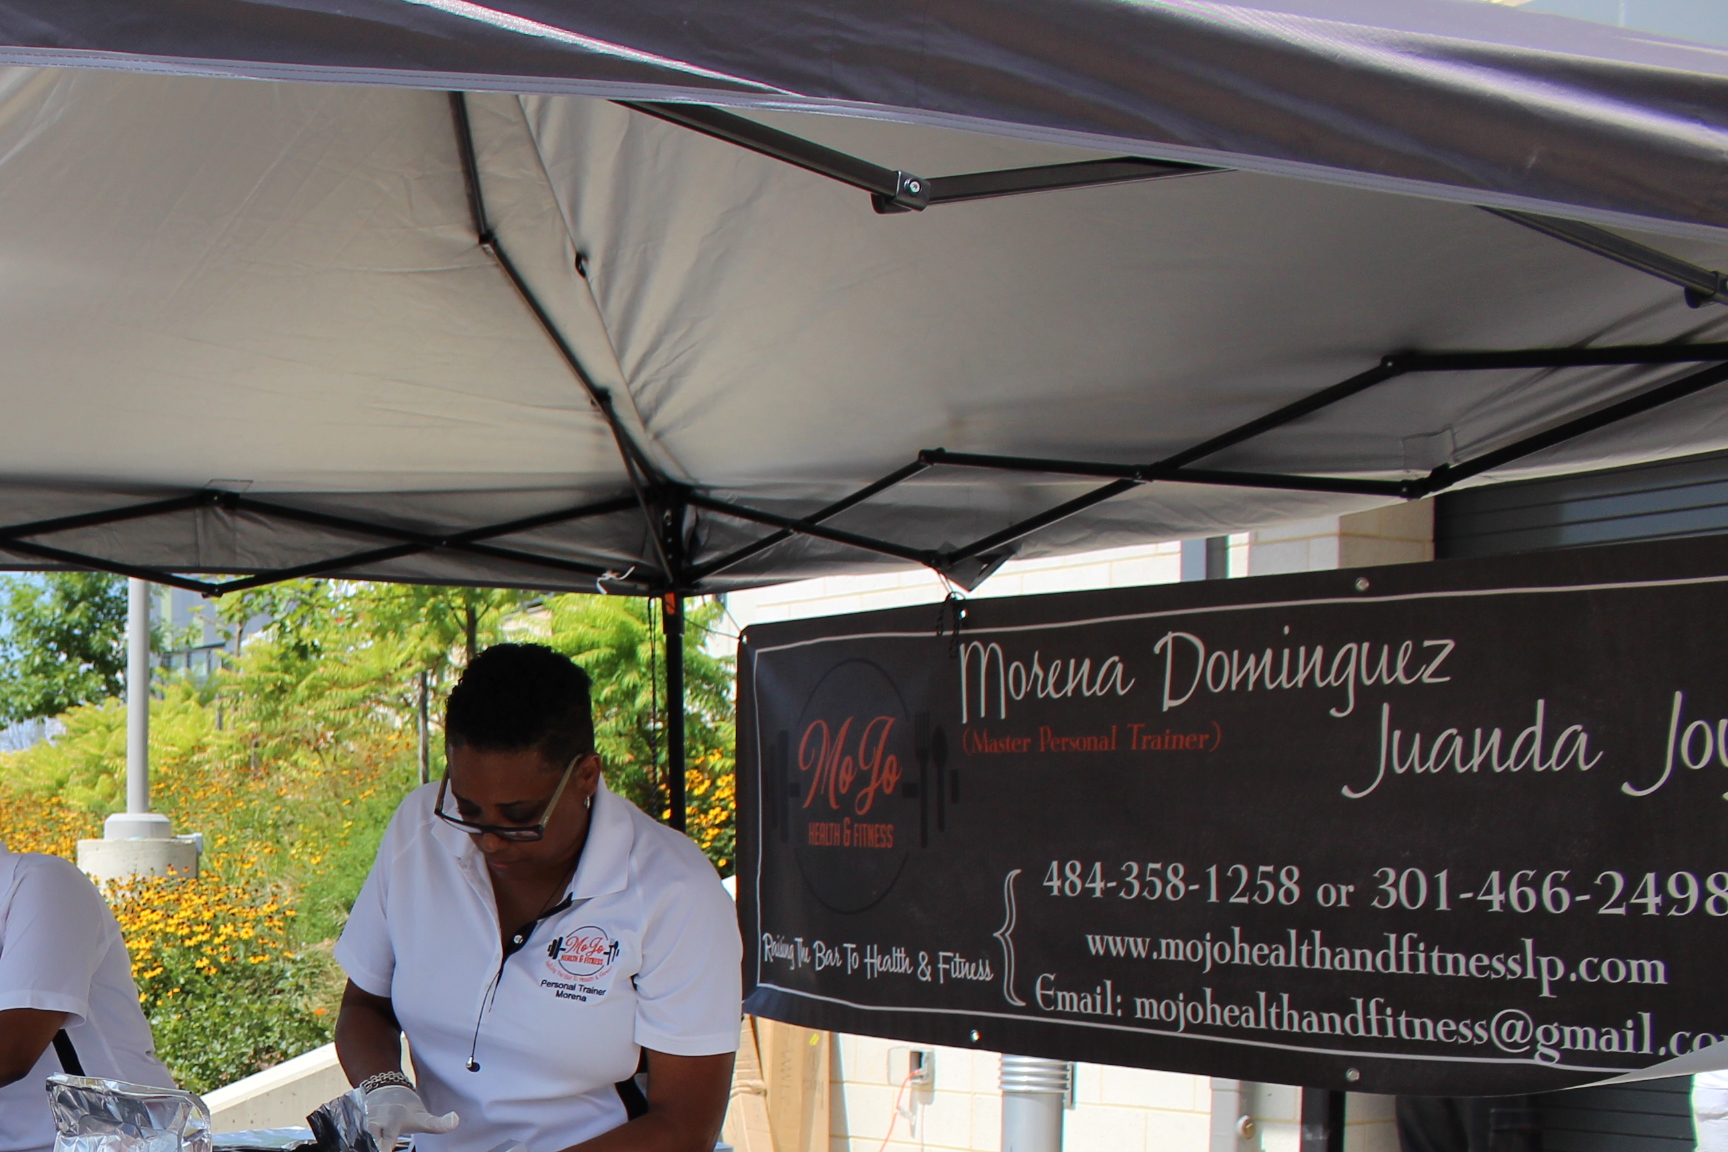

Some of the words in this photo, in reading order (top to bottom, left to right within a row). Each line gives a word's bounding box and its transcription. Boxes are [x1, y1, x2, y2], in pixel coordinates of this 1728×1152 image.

[960, 641, 1135, 724] Morena
[1153, 625, 1456, 718] Dominguez
[962, 728, 1032, 755] (Master
[1039, 725, 1118, 752] Personal
[1127, 721, 1222, 752] Trainer)
[1342, 699, 1604, 799] Juanda
[798, 715, 903, 816] MoJo
[808, 821, 841, 847] HEALTH
[843, 816, 852, 847] &
[853, 823, 894, 848] FITNESS
[1042, 860, 1301, 906] 484-358-1258
[1317, 881, 1355, 907] or
[1371, 866, 1728, 917] 301-466-2498
[566, 936, 604, 956] MoJo
[762, 932, 795, 970] Raising
[813, 940, 842, 971] Bar
[843, 943, 860, 975] To
[864, 944, 913, 979] Health
[917, 951, 932, 982] &
[937, 951, 994, 984] Fitness
[1085, 925, 1669, 998] www.mojohealthandfitnesslp.com
[540, 980, 576, 991] Personal
[579, 984, 606, 995] Trainer
[555, 990, 587, 1002] Morena
[1035, 973, 1123, 1017] Email:
[1134, 986, 1728, 1064] mojohealthandfitness@gmail.co
